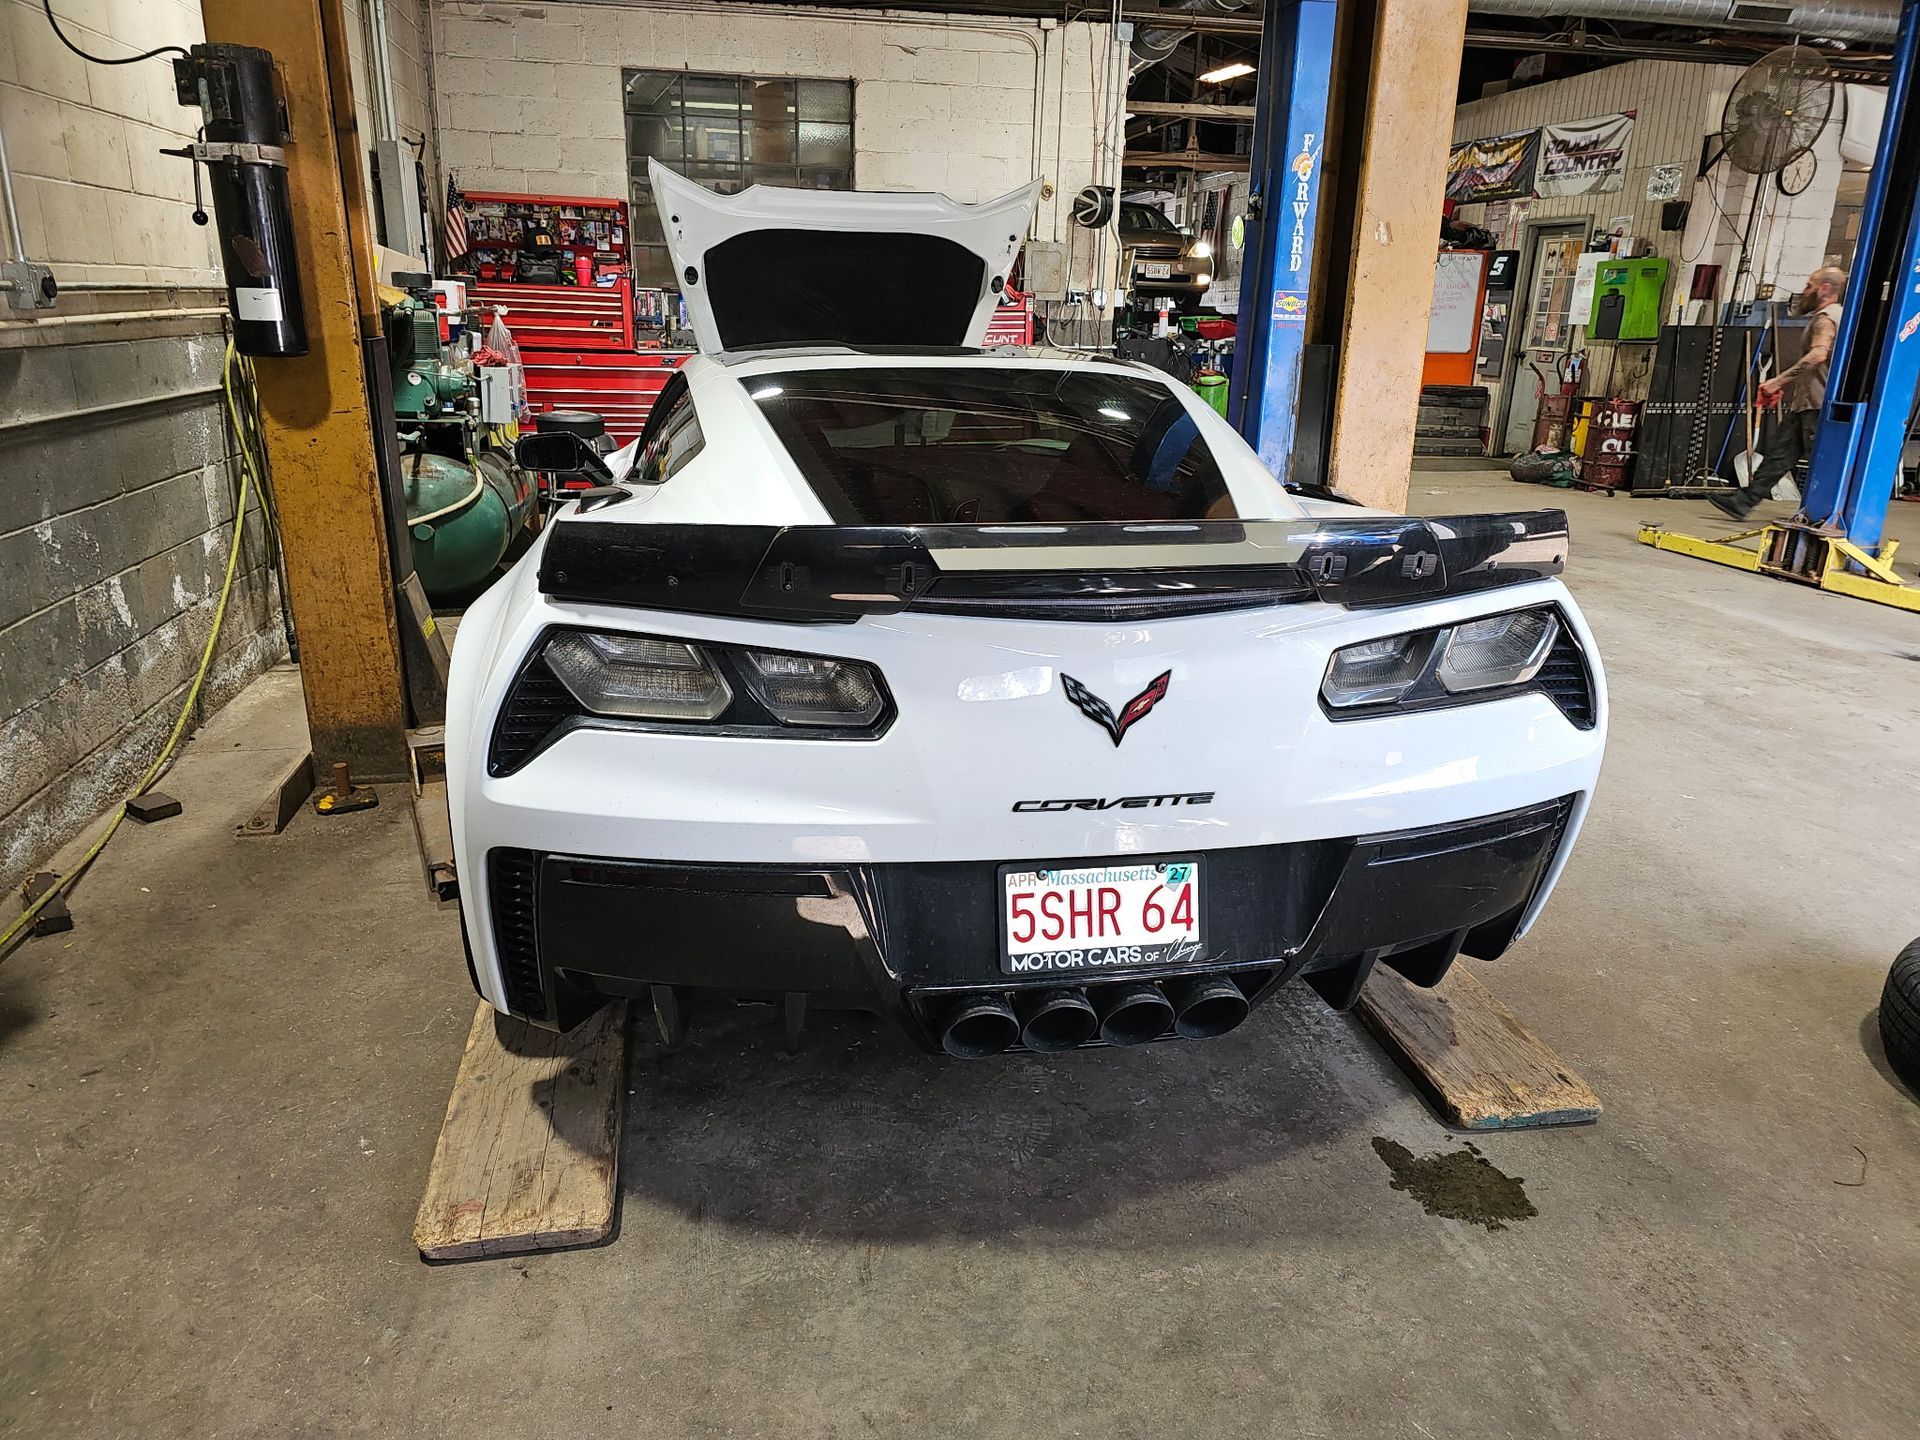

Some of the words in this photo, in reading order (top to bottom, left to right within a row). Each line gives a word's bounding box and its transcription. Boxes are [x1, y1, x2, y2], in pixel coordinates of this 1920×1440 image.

[1546, 133, 1601, 156] ROUGH
[1543, 150, 1624, 176] COUNTRY
[1473, 181, 1513, 191] PRODUCTS
[1538, 173, 1583, 183] SUSPENSION
[1583, 167, 1622, 179] SYSTEMS
[1276, 300, 1307, 308] SUNOCO
[1012, 791, 1216, 813] CORVETTE
[1008, 873, 1037, 888] APR
[1046, 866, 1158, 888] Massachusetts
[1169, 867, 1189, 882] 27
[1011, 887, 1122, 943] 5SHR
[1142, 883, 1194, 933] 64
[1011, 950, 1084, 972] MOTOR
[1086, 946, 1142, 966] CARS
